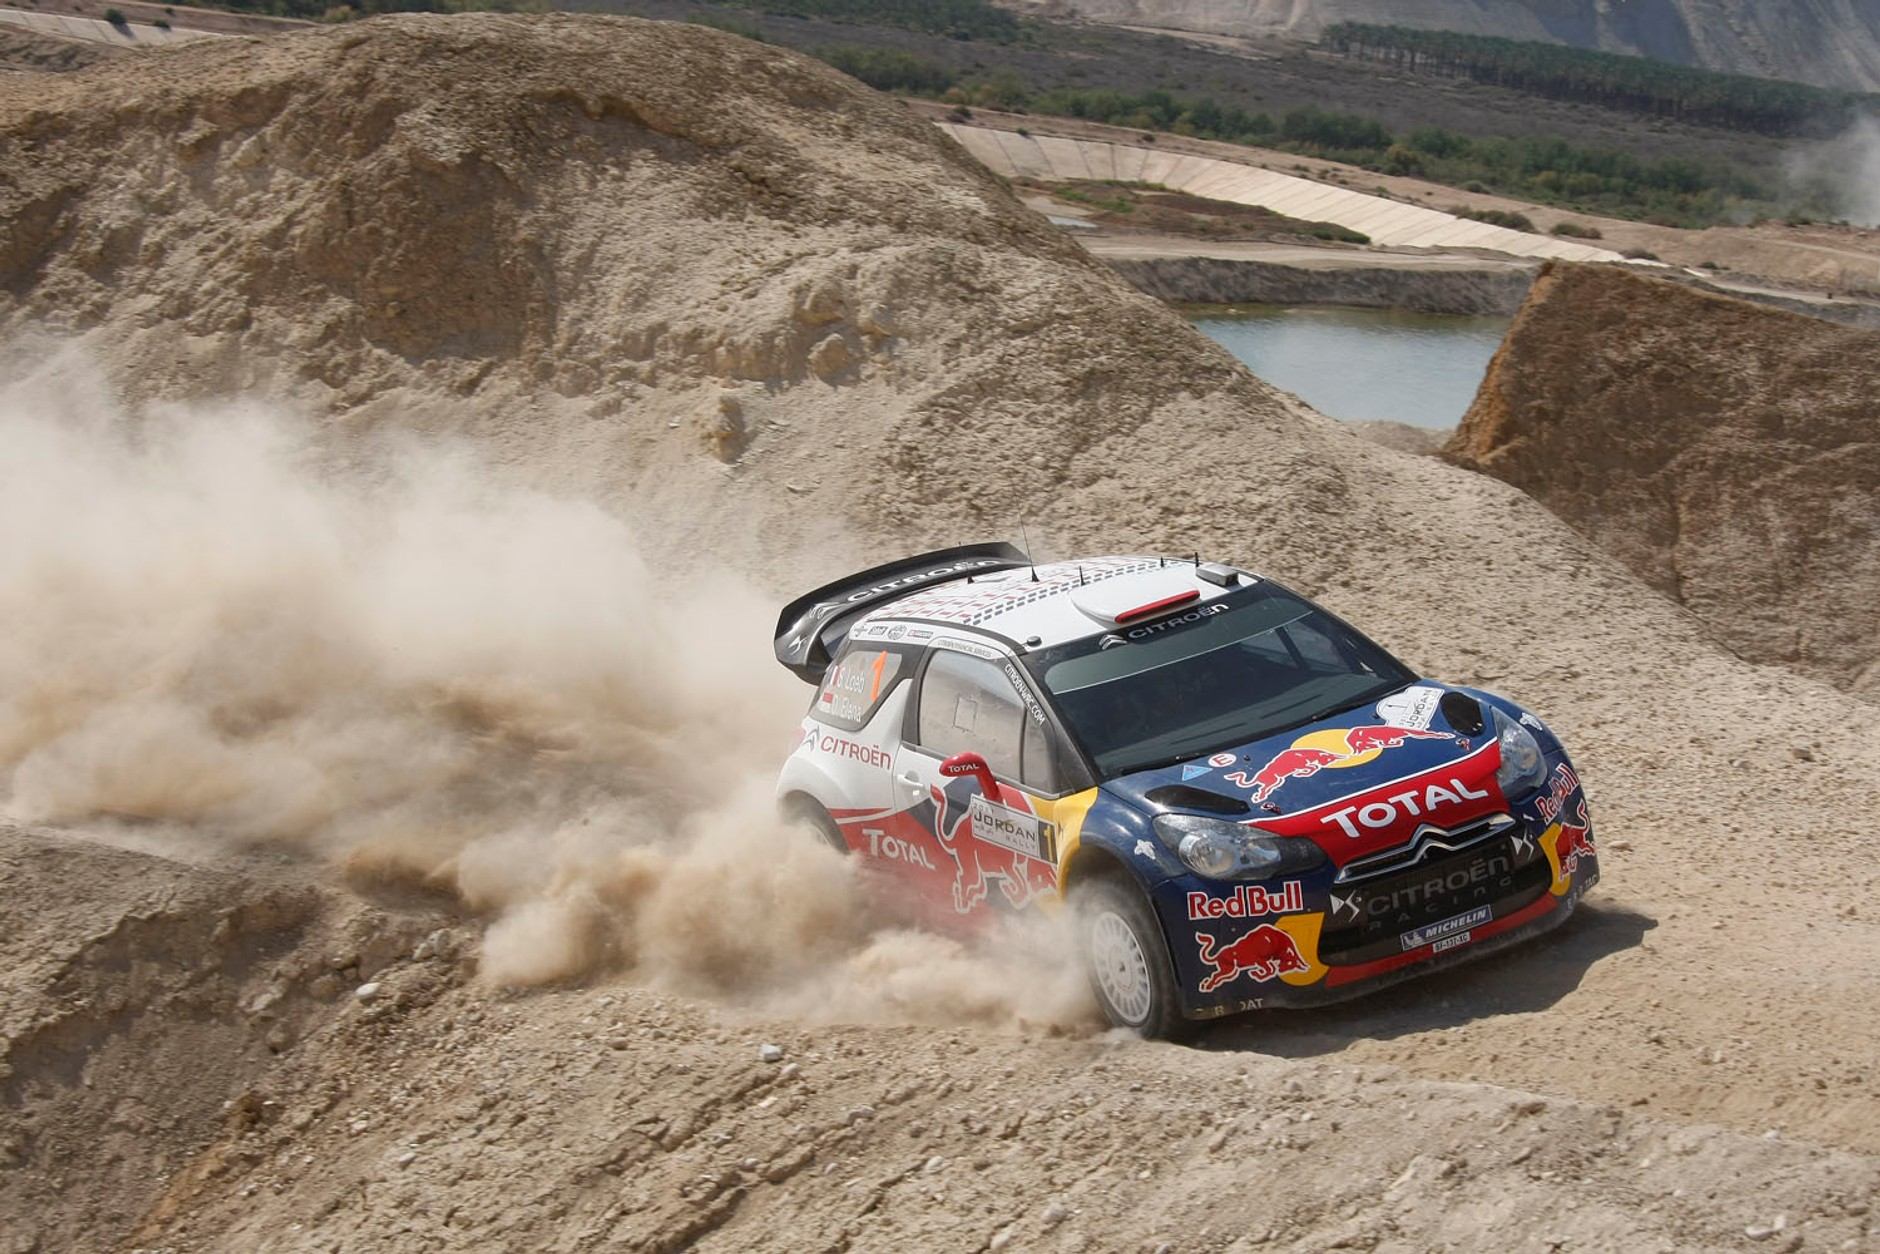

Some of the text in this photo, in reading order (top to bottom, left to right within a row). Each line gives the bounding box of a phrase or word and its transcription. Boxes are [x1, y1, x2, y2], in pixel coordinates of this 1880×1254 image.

[872, 651, 888, 702] 1
[947, 762, 980, 773] TOTAL
[973, 811, 1037, 842] JORDAN
[1320, 778, 1489, 838] TOTAL
[862, 828, 936, 871] TOTAL
[1187, 881, 1304, 920] Red Bull
[1425, 909, 1487, 938] MICHELIN
